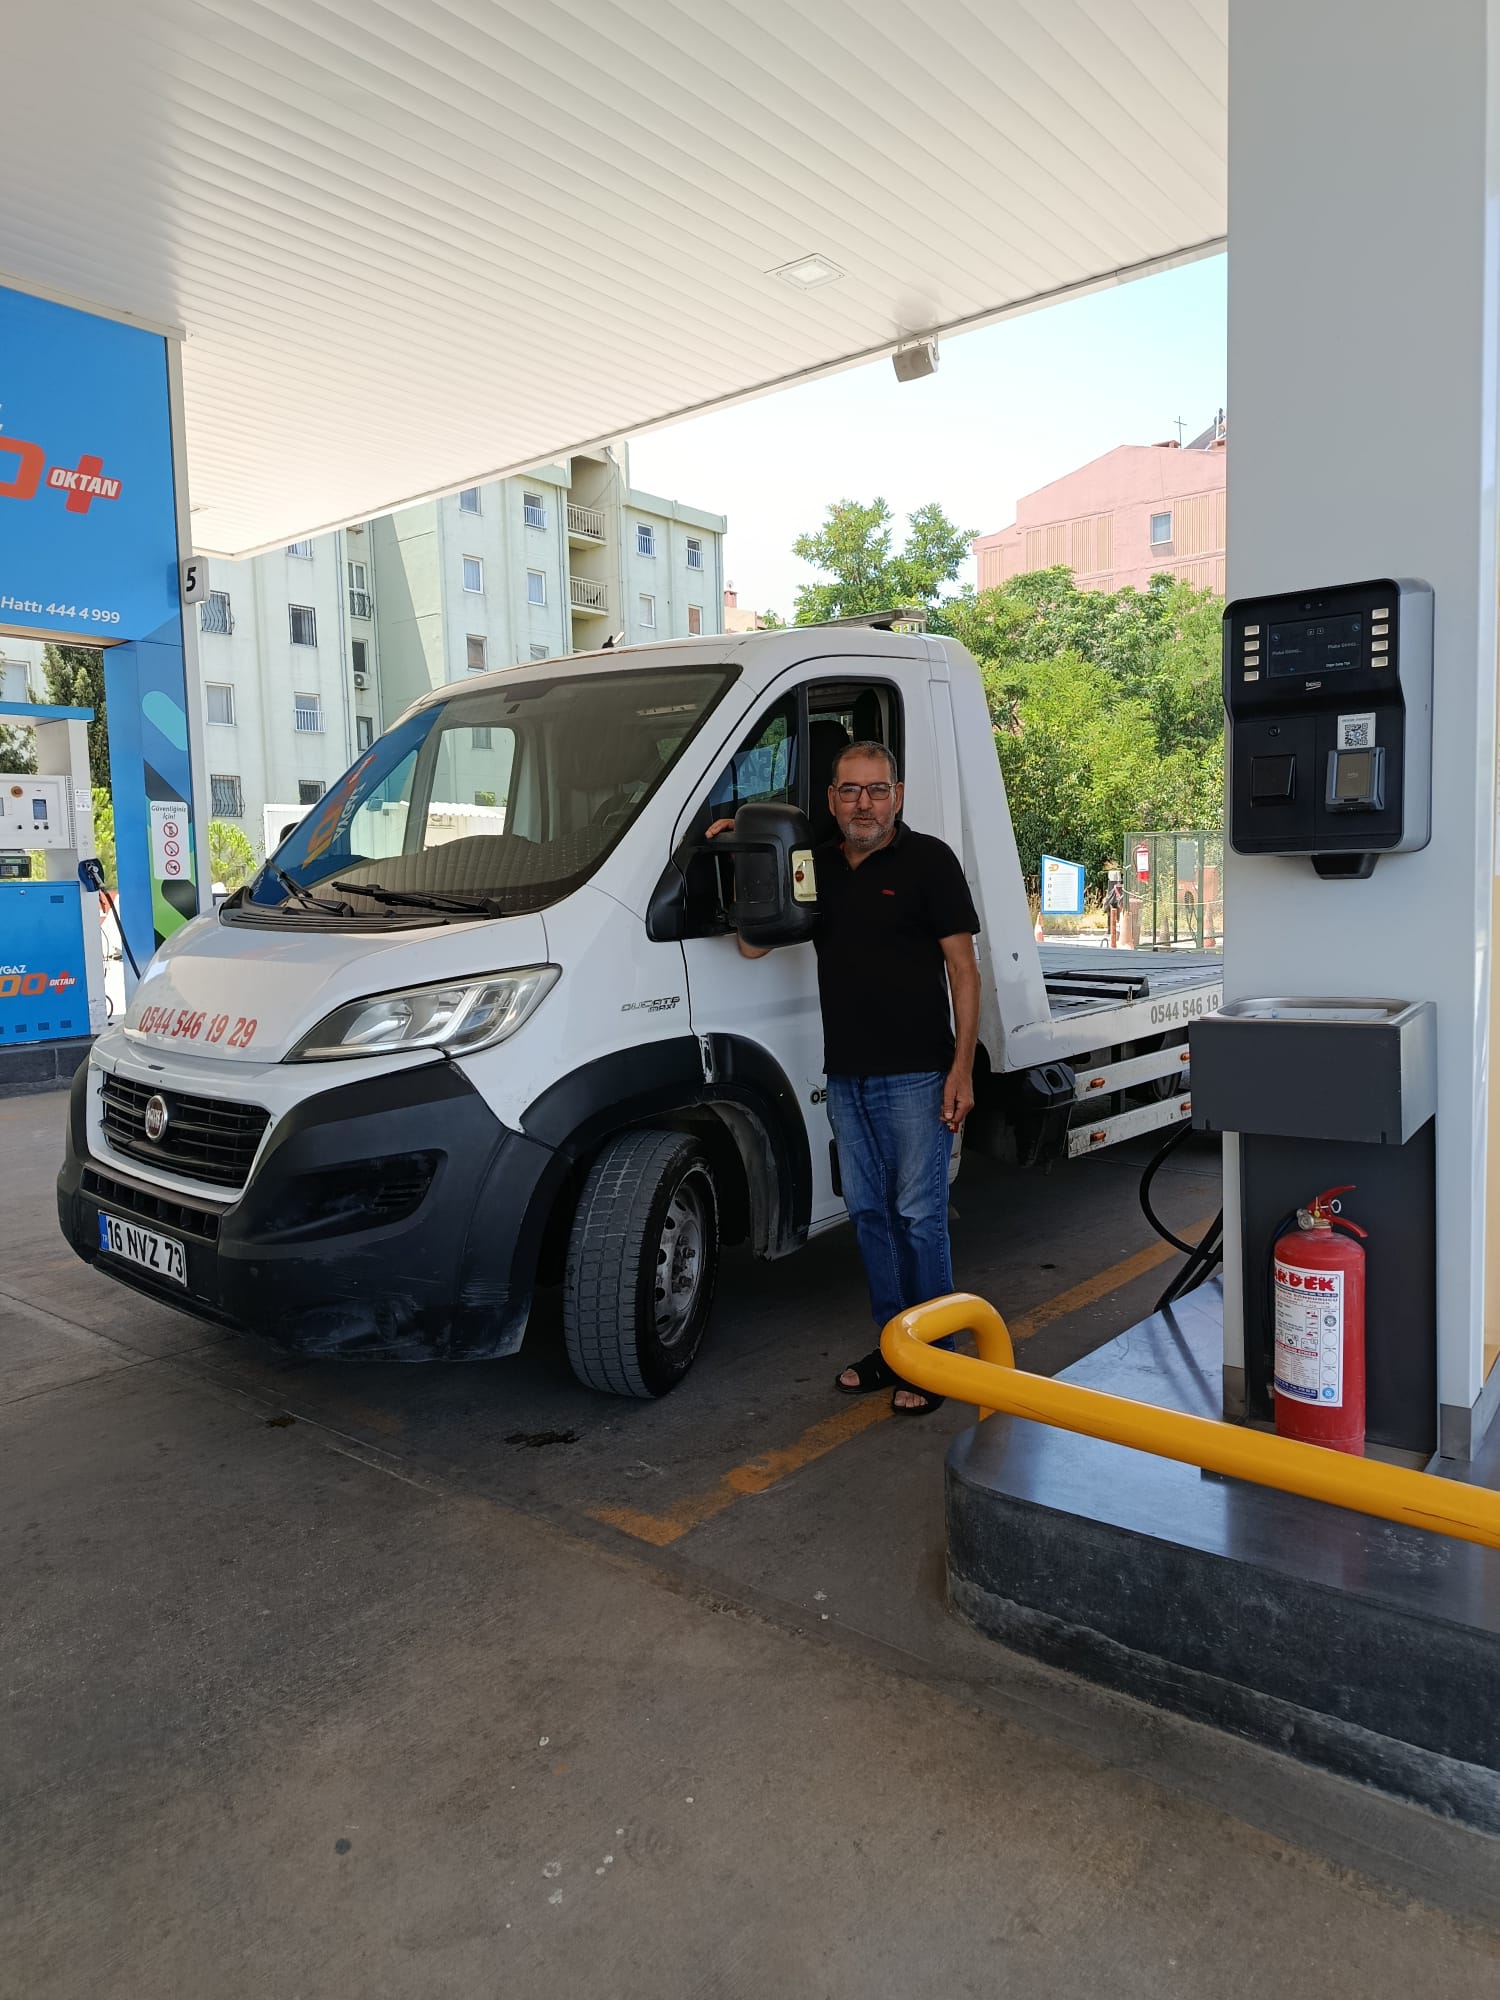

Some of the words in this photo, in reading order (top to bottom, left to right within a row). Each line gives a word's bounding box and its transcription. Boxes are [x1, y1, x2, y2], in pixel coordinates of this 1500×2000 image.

[50, 468, 119, 497] OKTAN
[186, 566, 197, 592] 5
[46, 603, 77, 618] 444
[79, 607, 89, 620] 4
[91, 608, 121, 624] 999
[49, 977, 76, 987] OKTAN
[1150, 1001, 1180, 1025] 0544
[1182, 997, 1203, 1019] 546
[1206, 994, 1219, 1013] 19
[138, 1006, 176, 1035] 0544
[171, 1009, 207, 1040] 546
[204, 1013, 229, 1043] 19
[226, 1017, 258, 1048] 29
[107, 1219, 122, 1251] 16
[126, 1226, 160, 1268] NVZ
[164, 1241, 183, 1278] 73
